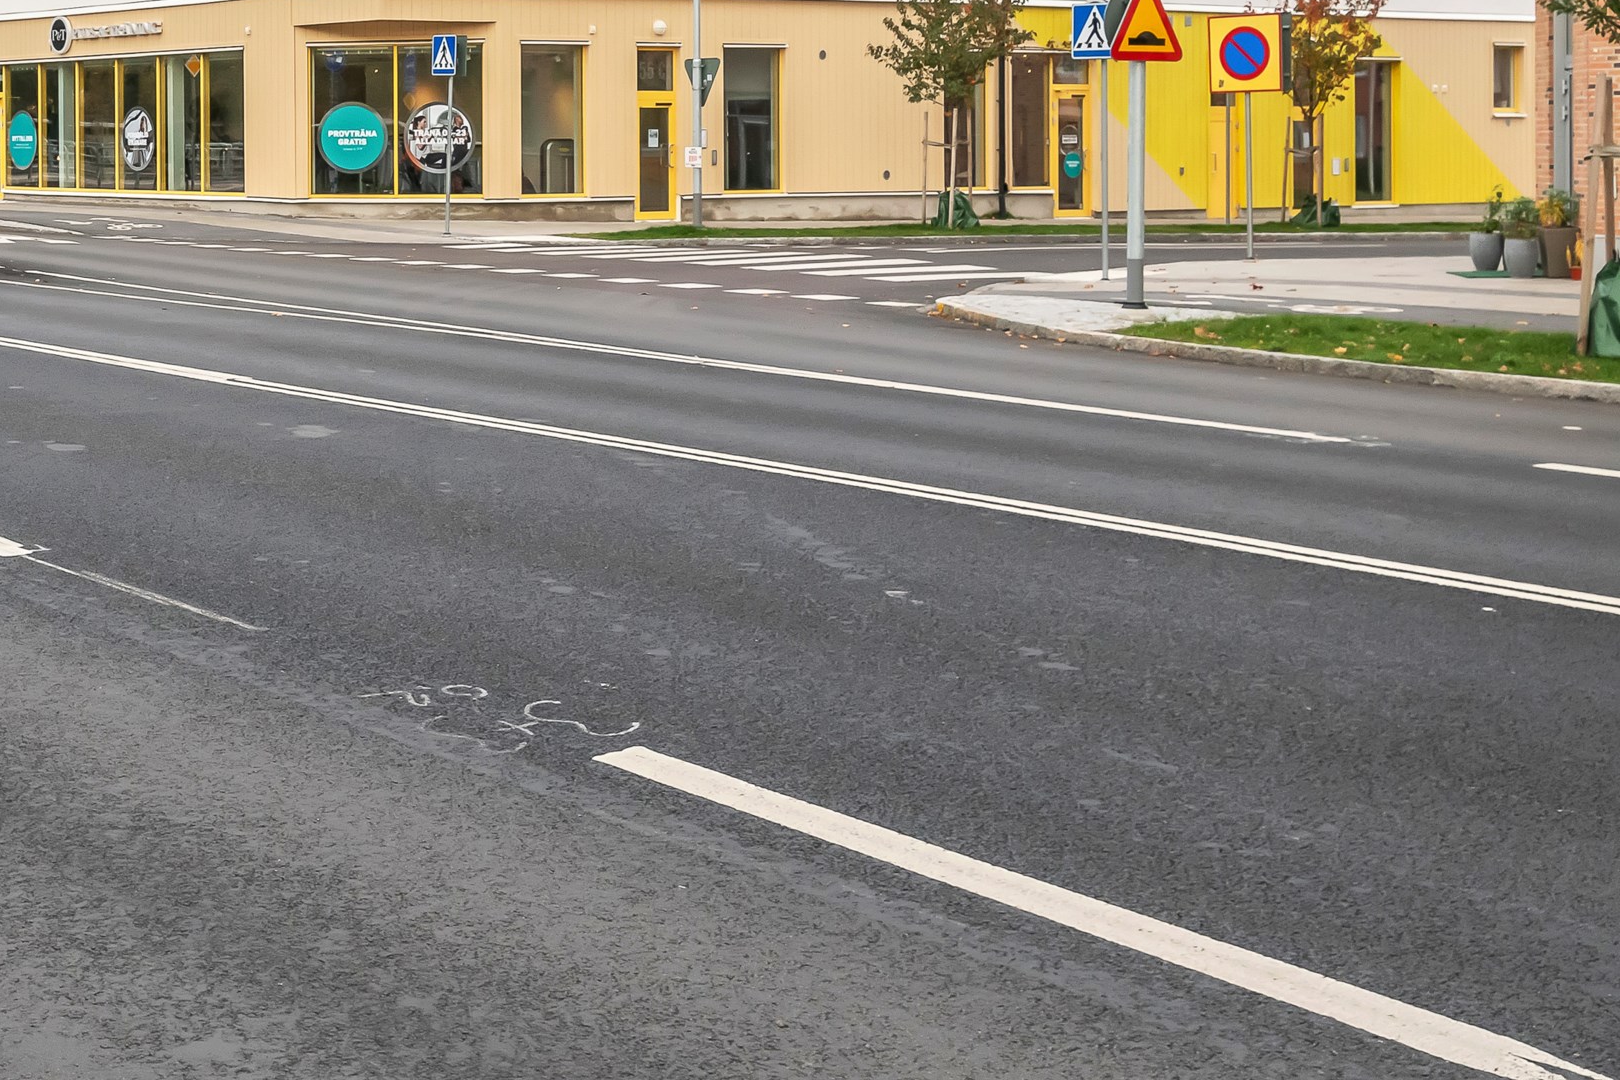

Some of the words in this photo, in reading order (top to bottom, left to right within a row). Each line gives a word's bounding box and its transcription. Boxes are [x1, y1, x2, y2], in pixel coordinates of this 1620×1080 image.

[52, 29, 66, 41] P&T
[327, 128, 377, 137] PROVTRÄNA
[413, 128, 441, 136] TRÄNA
[337, 138, 367, 146] GRATIS
[415, 137, 436, 145] ALLA
